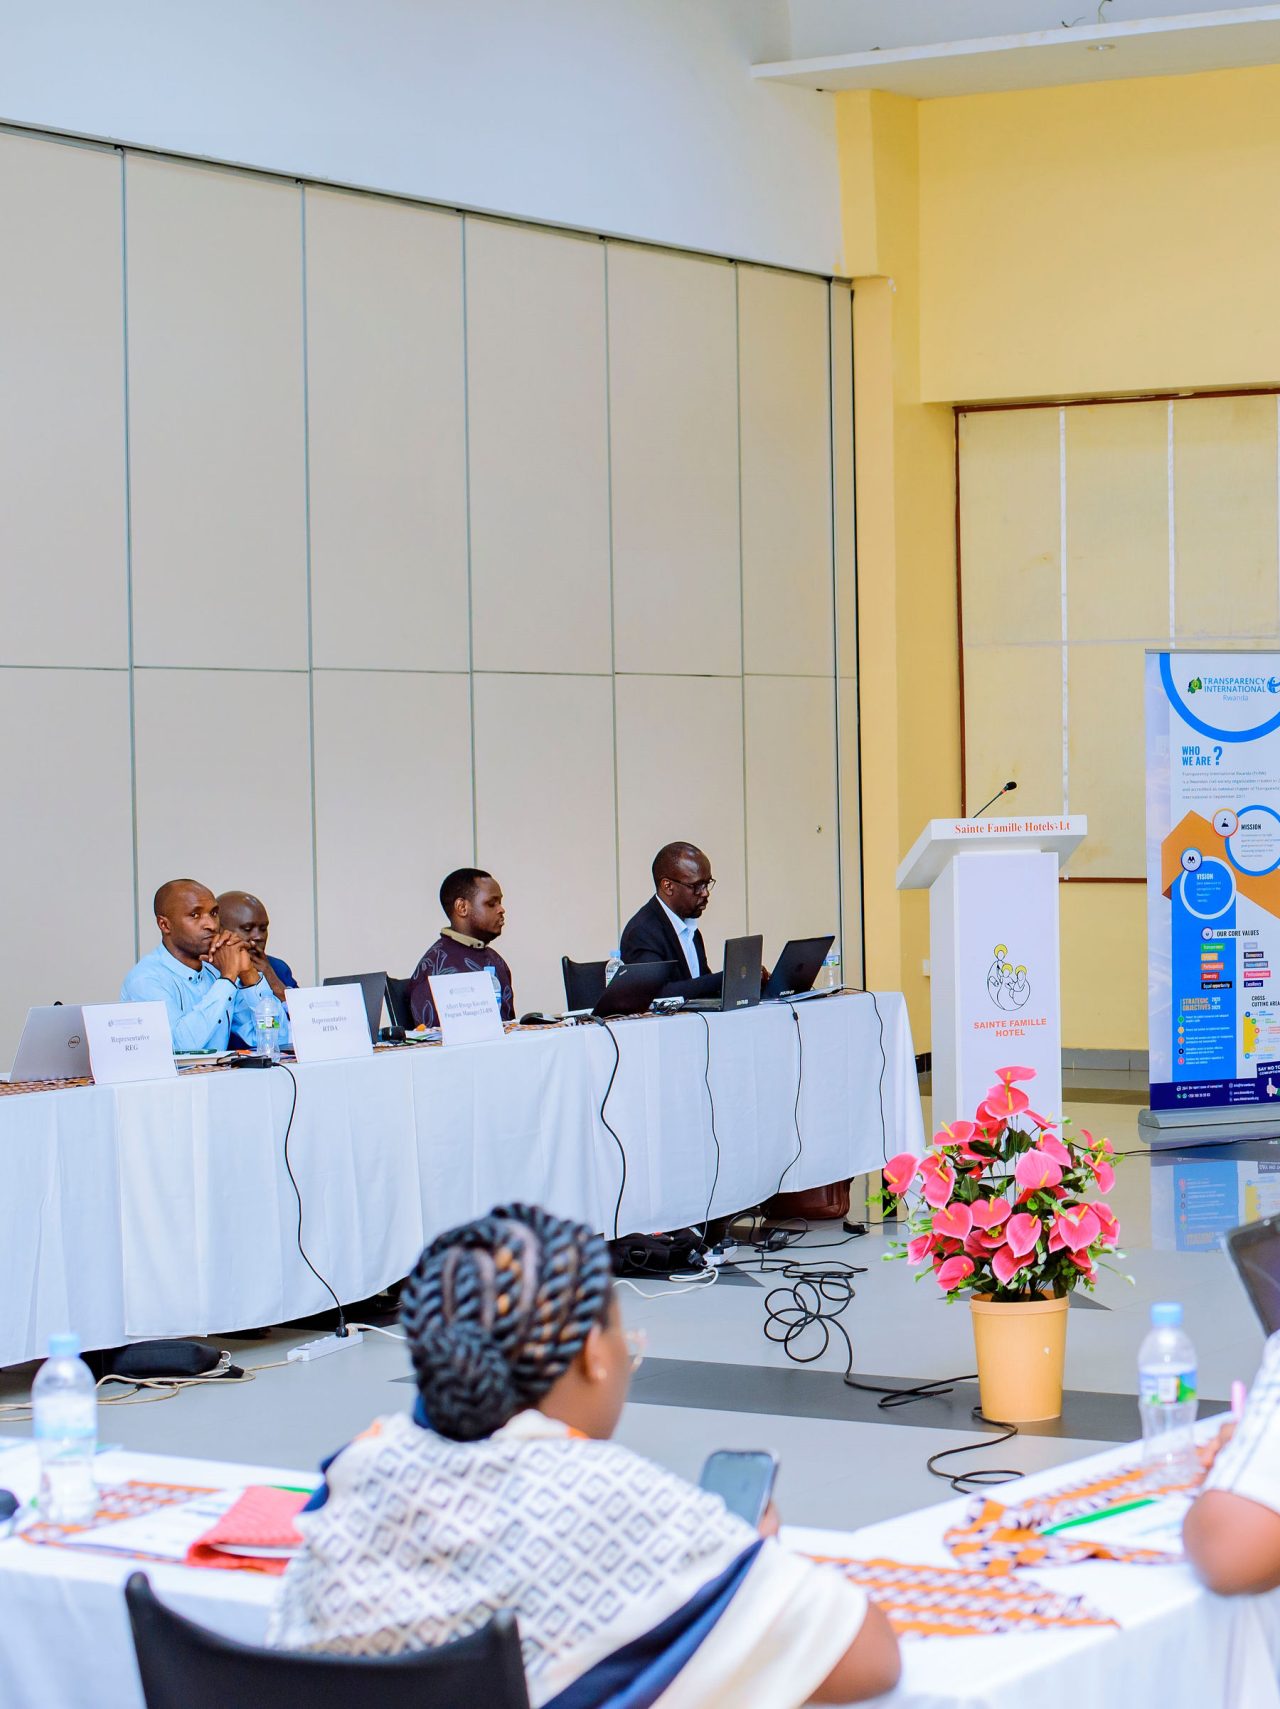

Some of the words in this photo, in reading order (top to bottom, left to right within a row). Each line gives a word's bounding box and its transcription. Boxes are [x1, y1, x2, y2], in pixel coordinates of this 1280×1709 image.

[1203, 677, 1266, 685] TRANSPARENCY
[1204, 685, 1266, 693] INTERNATIONAL
[1182, 746, 1200, 756] WHO
[1182, 756, 1193, 766] WE
[1196, 756, 1211, 765] ARE
[1213, 745, 1223, 765] ?
[955, 825, 984, 833] Sainte
[987, 822, 1022, 833] Famille
[974, 1021, 1006, 1029] SAINTE
[1009, 1018, 1047, 1027] FAMILLE
[996, 1029, 1025, 1037] HOTEL
